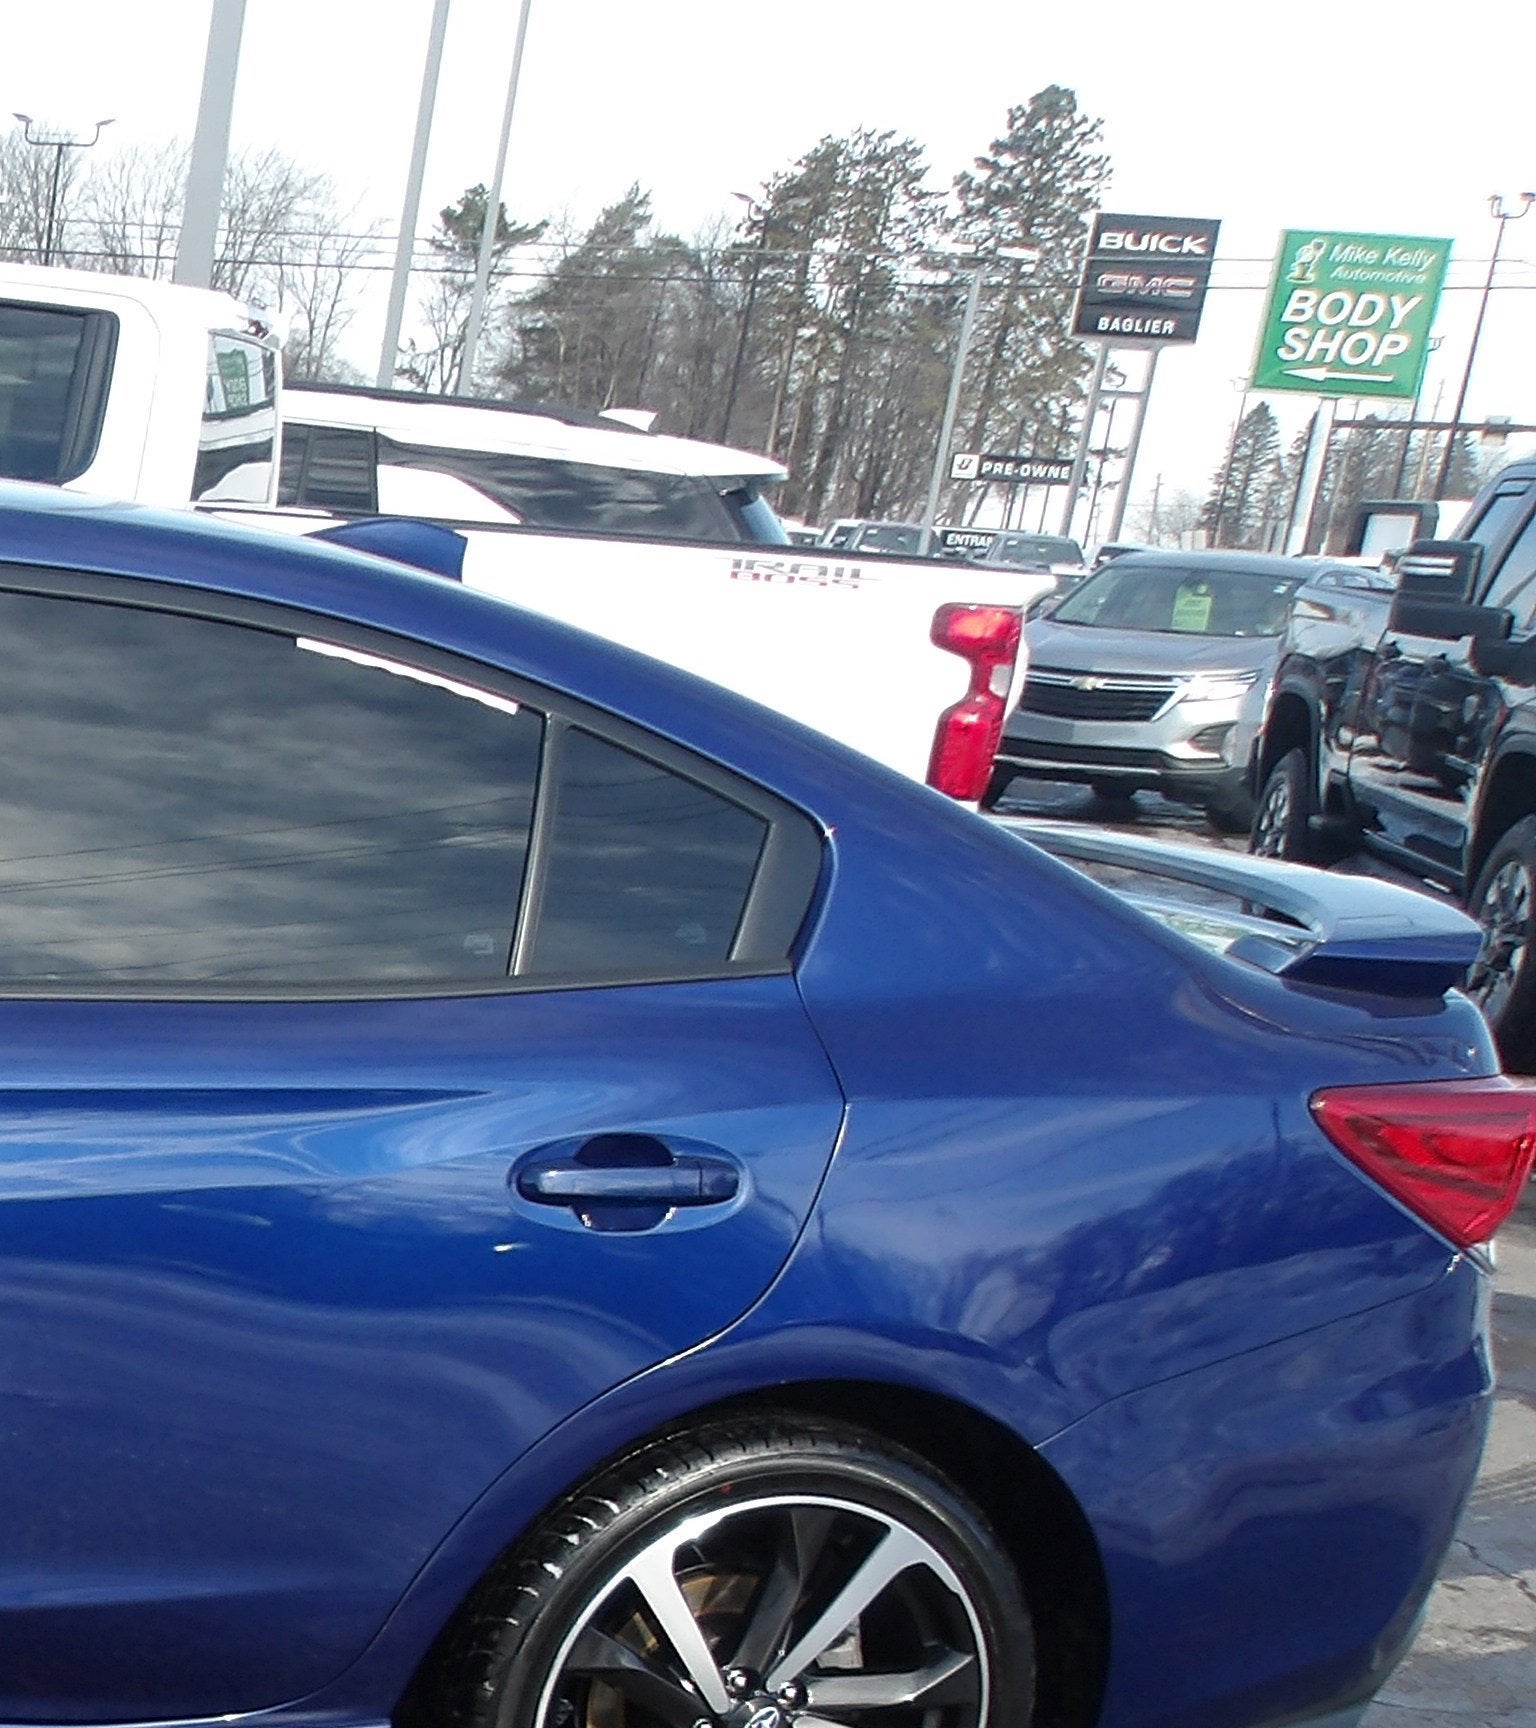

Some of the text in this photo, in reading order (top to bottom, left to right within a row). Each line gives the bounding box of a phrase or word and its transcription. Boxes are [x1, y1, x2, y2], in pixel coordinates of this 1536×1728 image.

[1098, 231, 1209, 255] BUICK
[1328, 243, 1436, 271] Mike Kelly
[1096, 273, 1196, 298] GMC
[1330, 266, 1427, 284] Automotive
[1281, 289, 1423, 329] BODY
[1097, 316, 1176, 334] BAGLIER
[1277, 327, 1408, 367] SHOP
[981, 461, 1070, 479] PRE-OWNE
